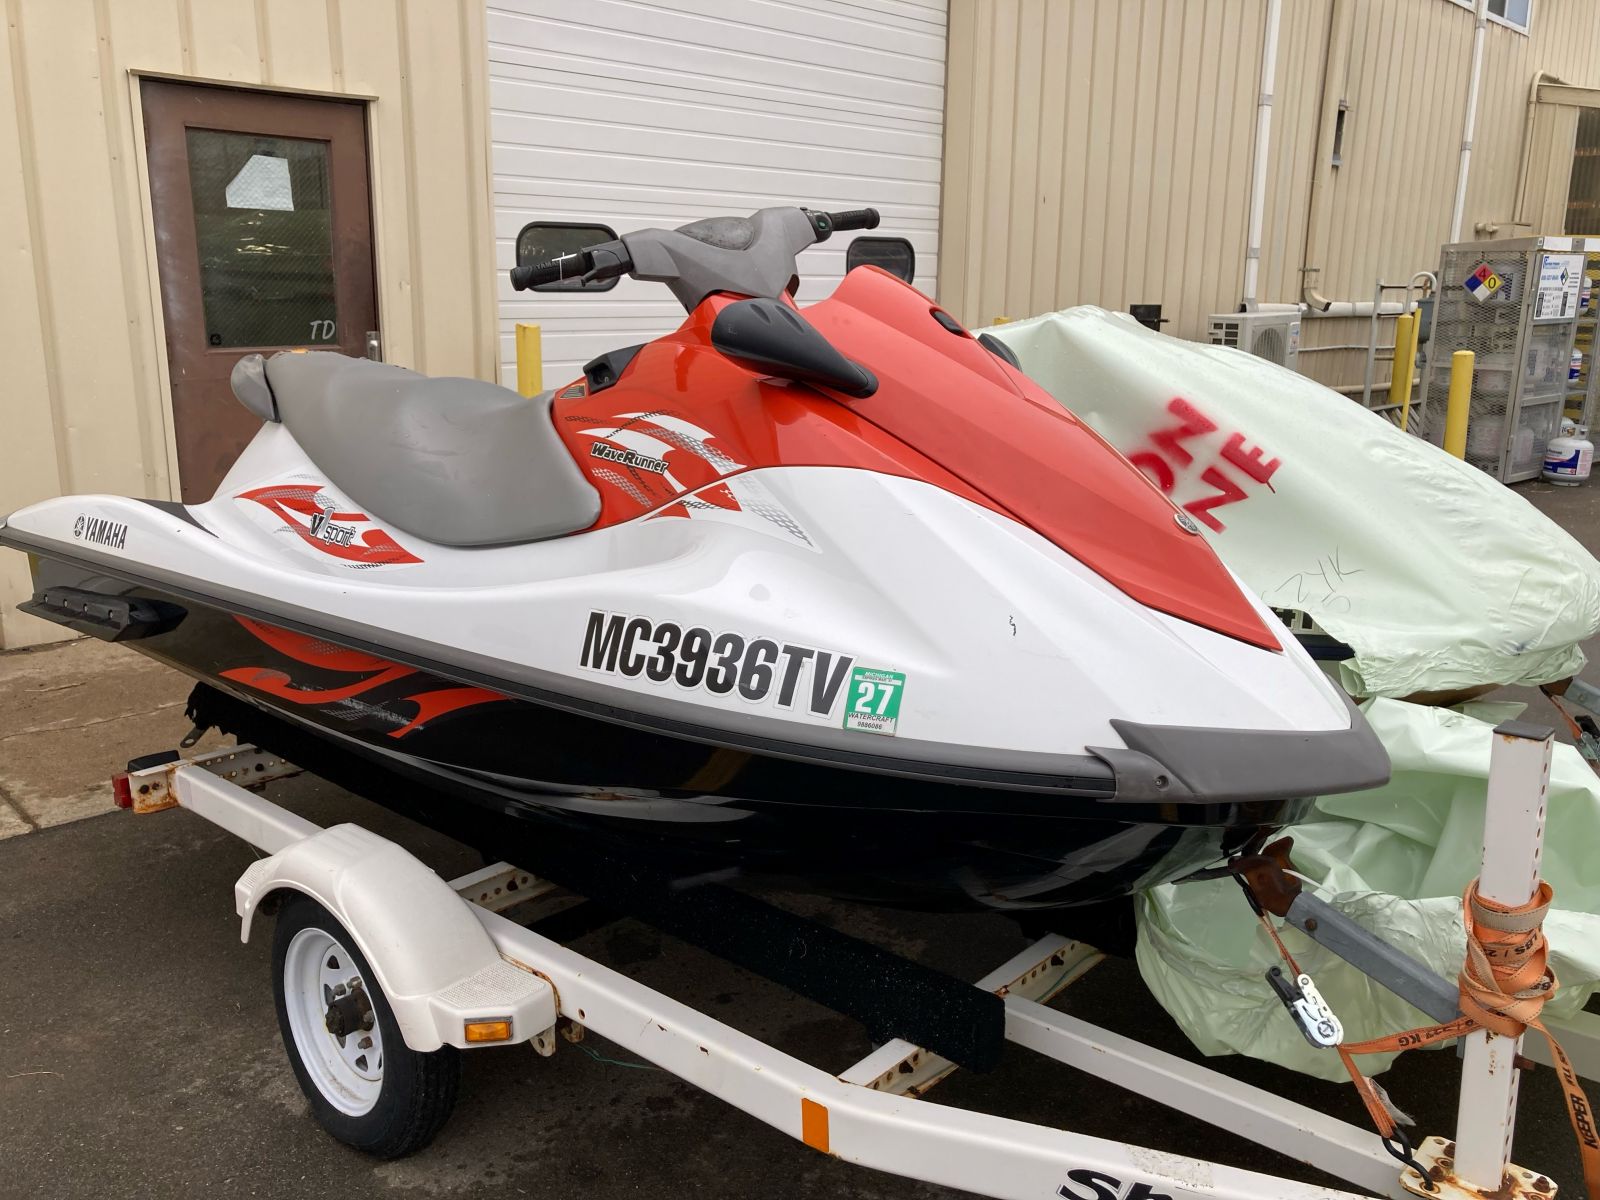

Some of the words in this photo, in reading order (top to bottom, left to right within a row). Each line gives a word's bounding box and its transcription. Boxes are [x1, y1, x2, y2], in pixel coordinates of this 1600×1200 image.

[1478, 267, 1487, 280] 4
[1488, 277, 1497, 289] 0
[310, 320, 335, 340] TD
[591, 442, 669, 474] WaveRunner
[85, 517, 128, 549] YAMAHA
[580, 611, 854, 716] MC3936TV
[864, 671, 894, 679] MICHIGAN
[855, 682, 894, 715] 27
[848, 712, 894, 723] WATERCRAFT
[1398, 1033, 1421, 1046] KG
[1570, 1093, 1599, 1150] KEEPER
